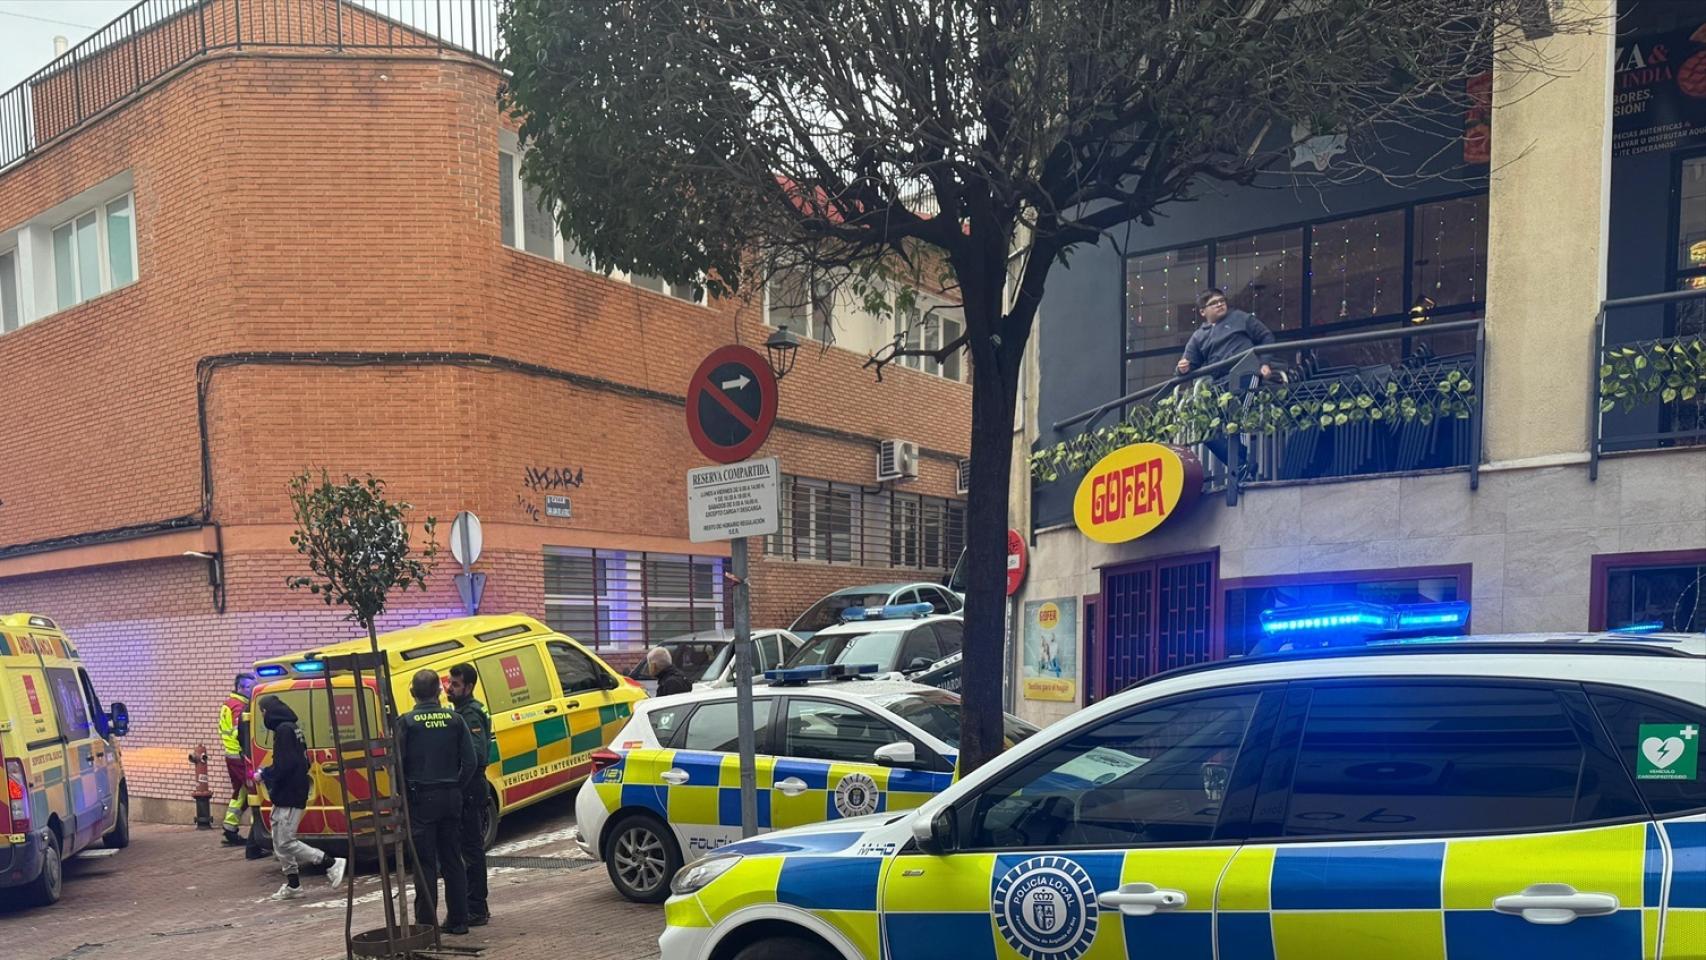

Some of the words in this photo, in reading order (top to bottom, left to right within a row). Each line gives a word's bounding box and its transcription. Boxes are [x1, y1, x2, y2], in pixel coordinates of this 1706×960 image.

[692, 471, 721, 486] RESERVA
[723, 464, 770, 481] COMPARTIDA
[1091, 458, 1166, 525] GOFER
[1039, 609, 1057, 622] GOFER
[413, 712, 453, 721] GUARDIA
[425, 720, 448, 729] CIVIL
[503, 769, 538, 787] VEHÍCULO
[541, 765, 549, 775] DE
[690, 834, 732, 850] POLICÍ
[1013, 876, 1048, 905] POLICÍA
[1049, 877, 1075, 908] LOCAL
